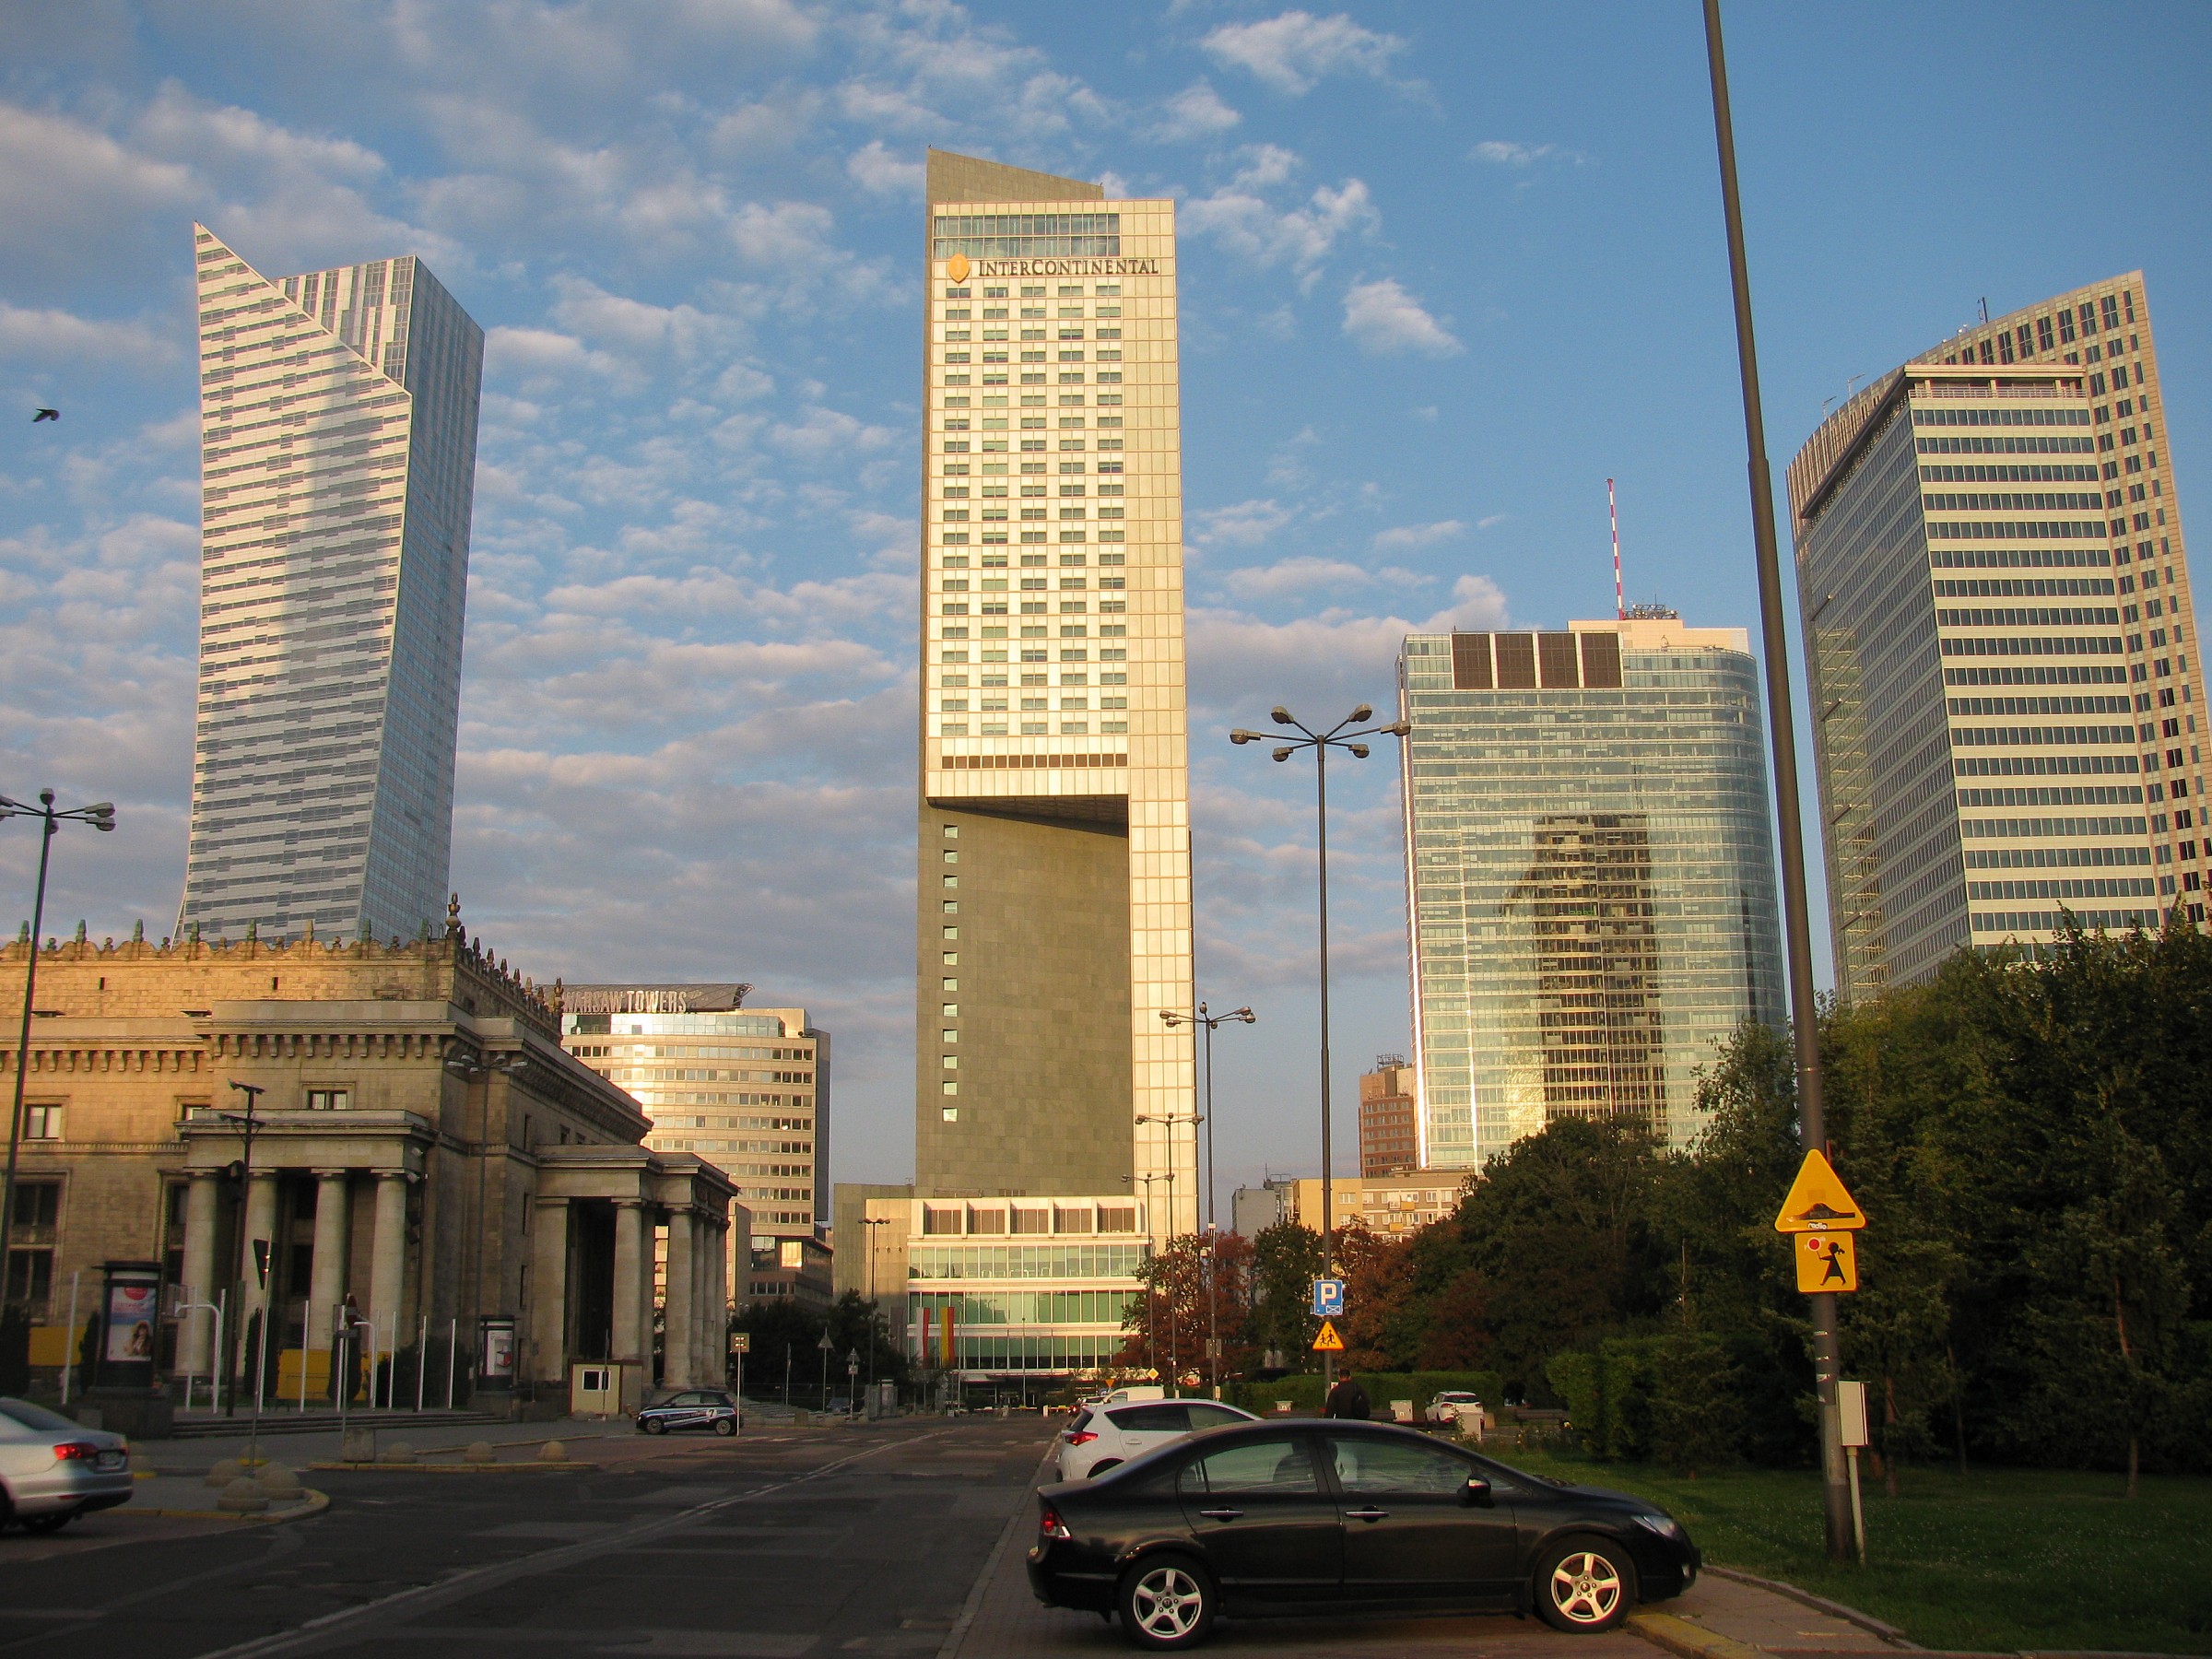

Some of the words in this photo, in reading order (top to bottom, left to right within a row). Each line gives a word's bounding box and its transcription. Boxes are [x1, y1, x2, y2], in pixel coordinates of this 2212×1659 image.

[979, 259, 1159, 276] INTERCONTINENTAL
[561, 991, 622, 1013] WARSAW
[627, 990, 687, 1013] TOWERS
[1321, 1283, 1337, 1305] P
[708, 1408, 715, 1418] 7
